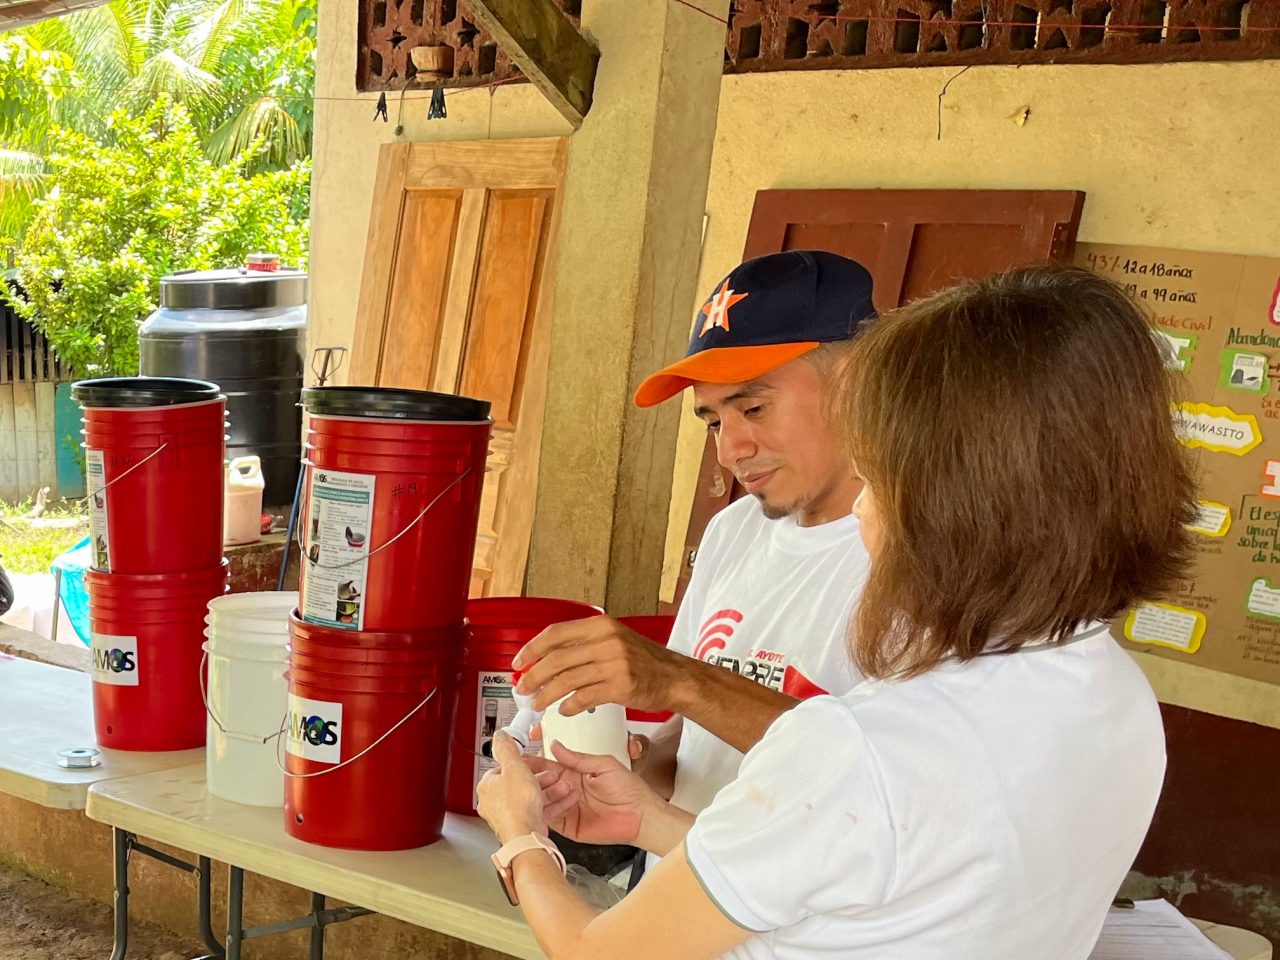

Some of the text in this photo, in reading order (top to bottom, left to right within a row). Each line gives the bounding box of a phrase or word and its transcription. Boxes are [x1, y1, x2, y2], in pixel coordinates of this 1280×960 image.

[1122, 259, 1138, 274] 12
[1149, 262, 1166, 277] 18
[707, 289, 734, 329] H
[754, 650, 787, 664] AYOTE
